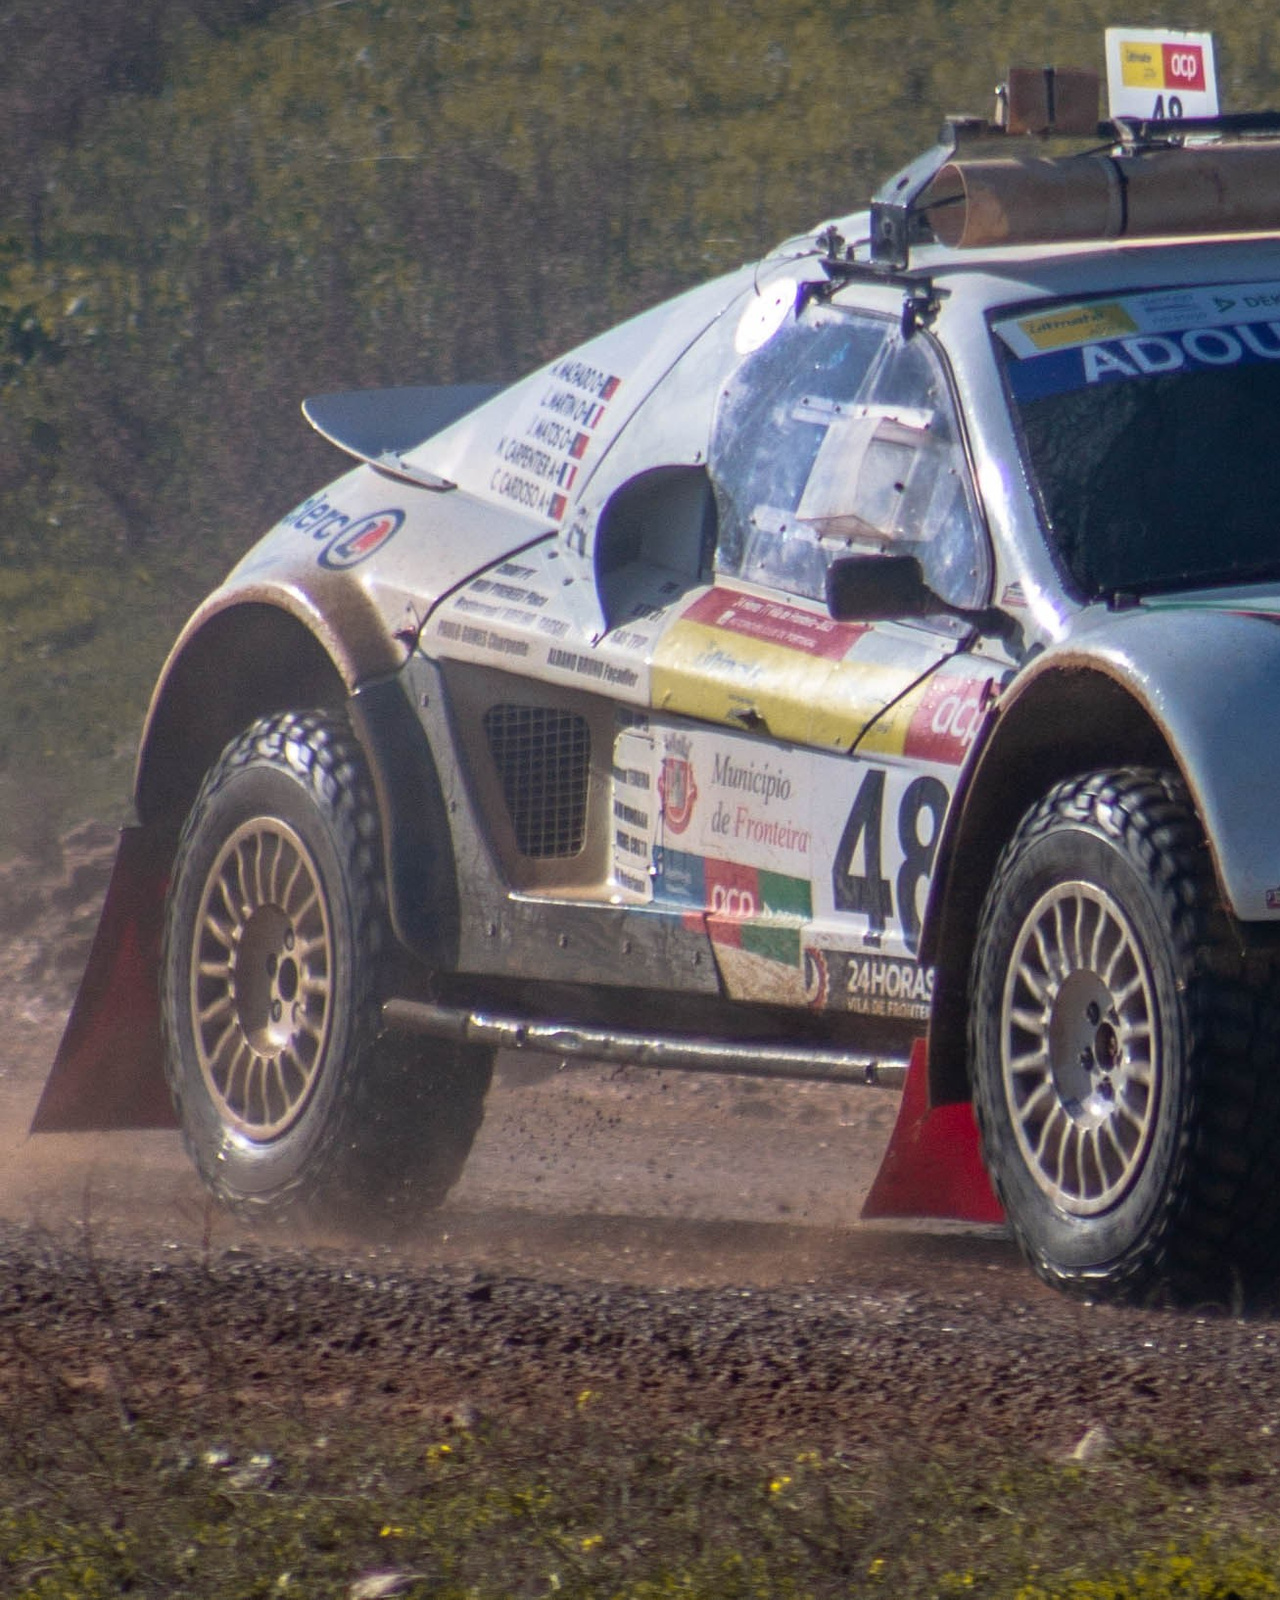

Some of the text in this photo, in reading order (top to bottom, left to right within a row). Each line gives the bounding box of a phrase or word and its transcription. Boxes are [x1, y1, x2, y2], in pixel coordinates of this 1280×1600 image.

[1171, 53, 1198, 82] acp
[711, 801, 810, 853] de Fronteira
[831, 770, 951, 955] 48
